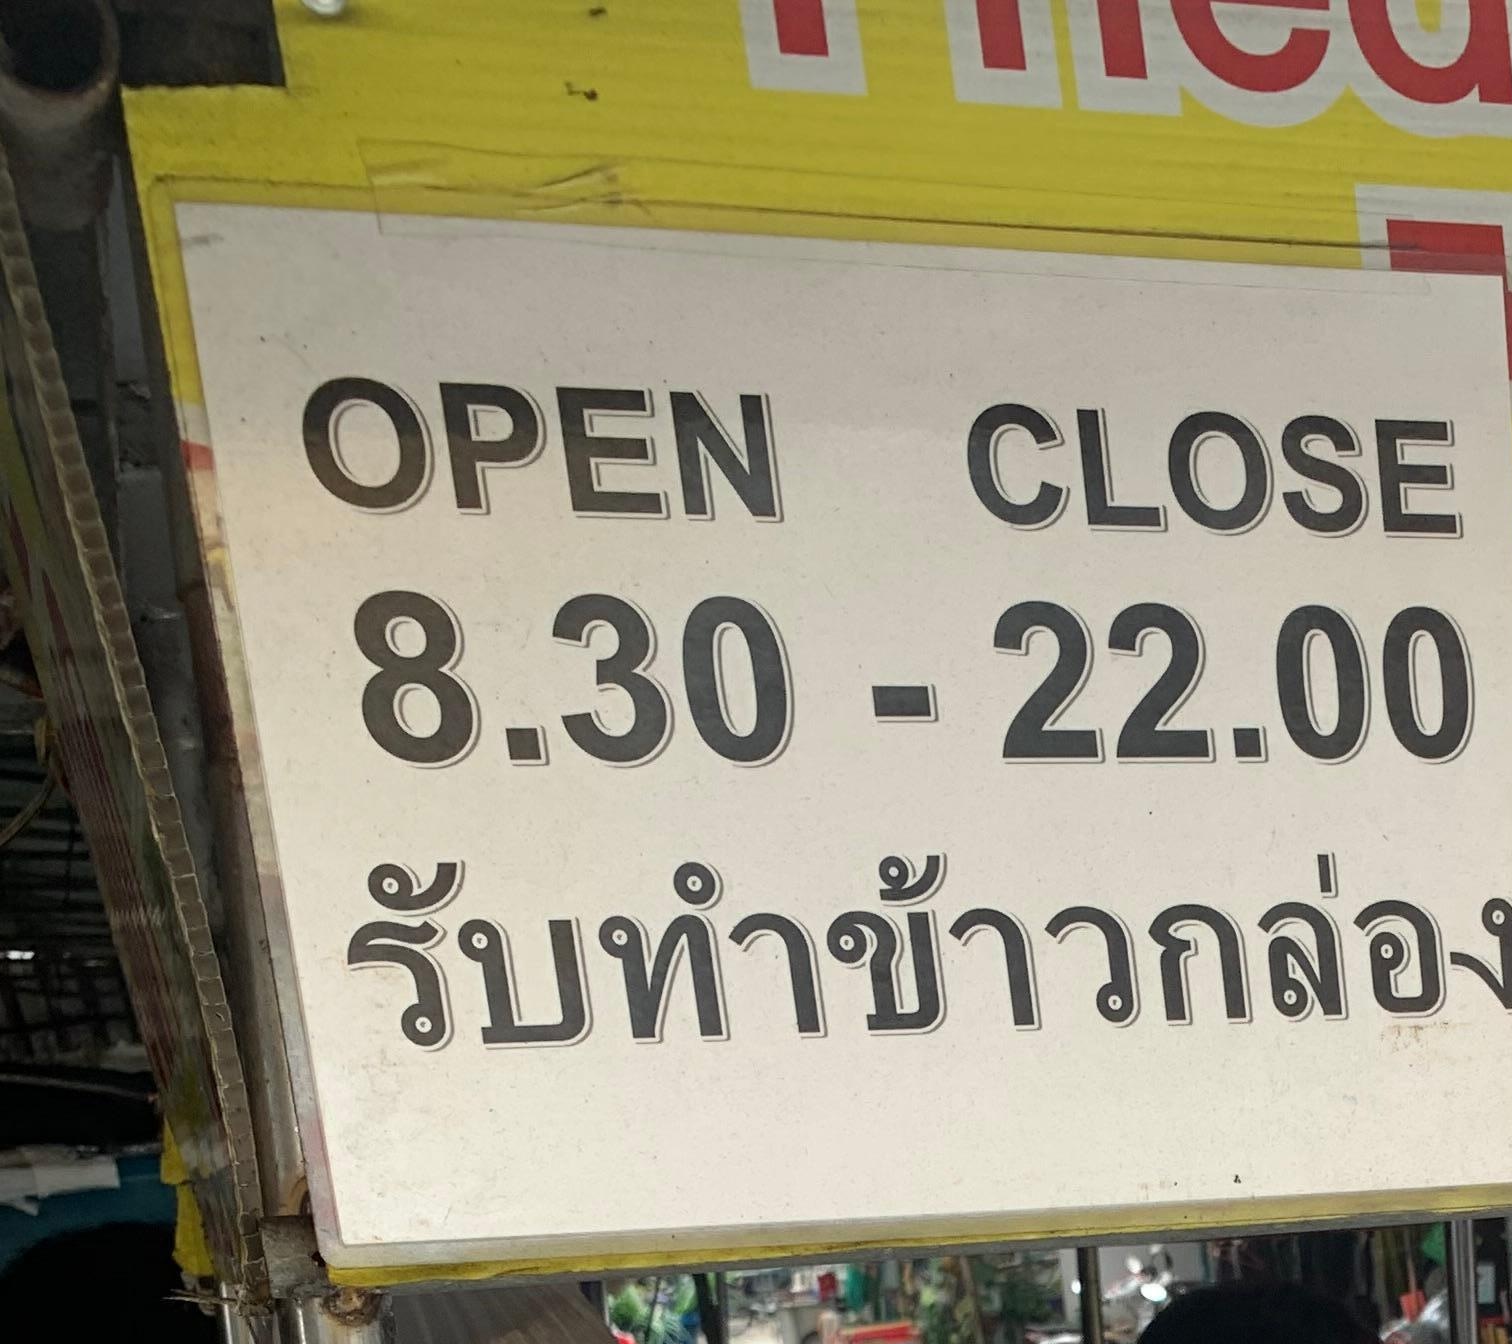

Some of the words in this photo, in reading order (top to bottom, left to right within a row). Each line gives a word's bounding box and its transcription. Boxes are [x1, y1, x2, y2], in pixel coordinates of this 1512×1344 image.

[302, 376, 784, 521] OPEN
[966, 403, 1464, 540] CLOSE
[353, 589, 794, 766] 8.30
[991, 599, 1477, 765] 22.00
